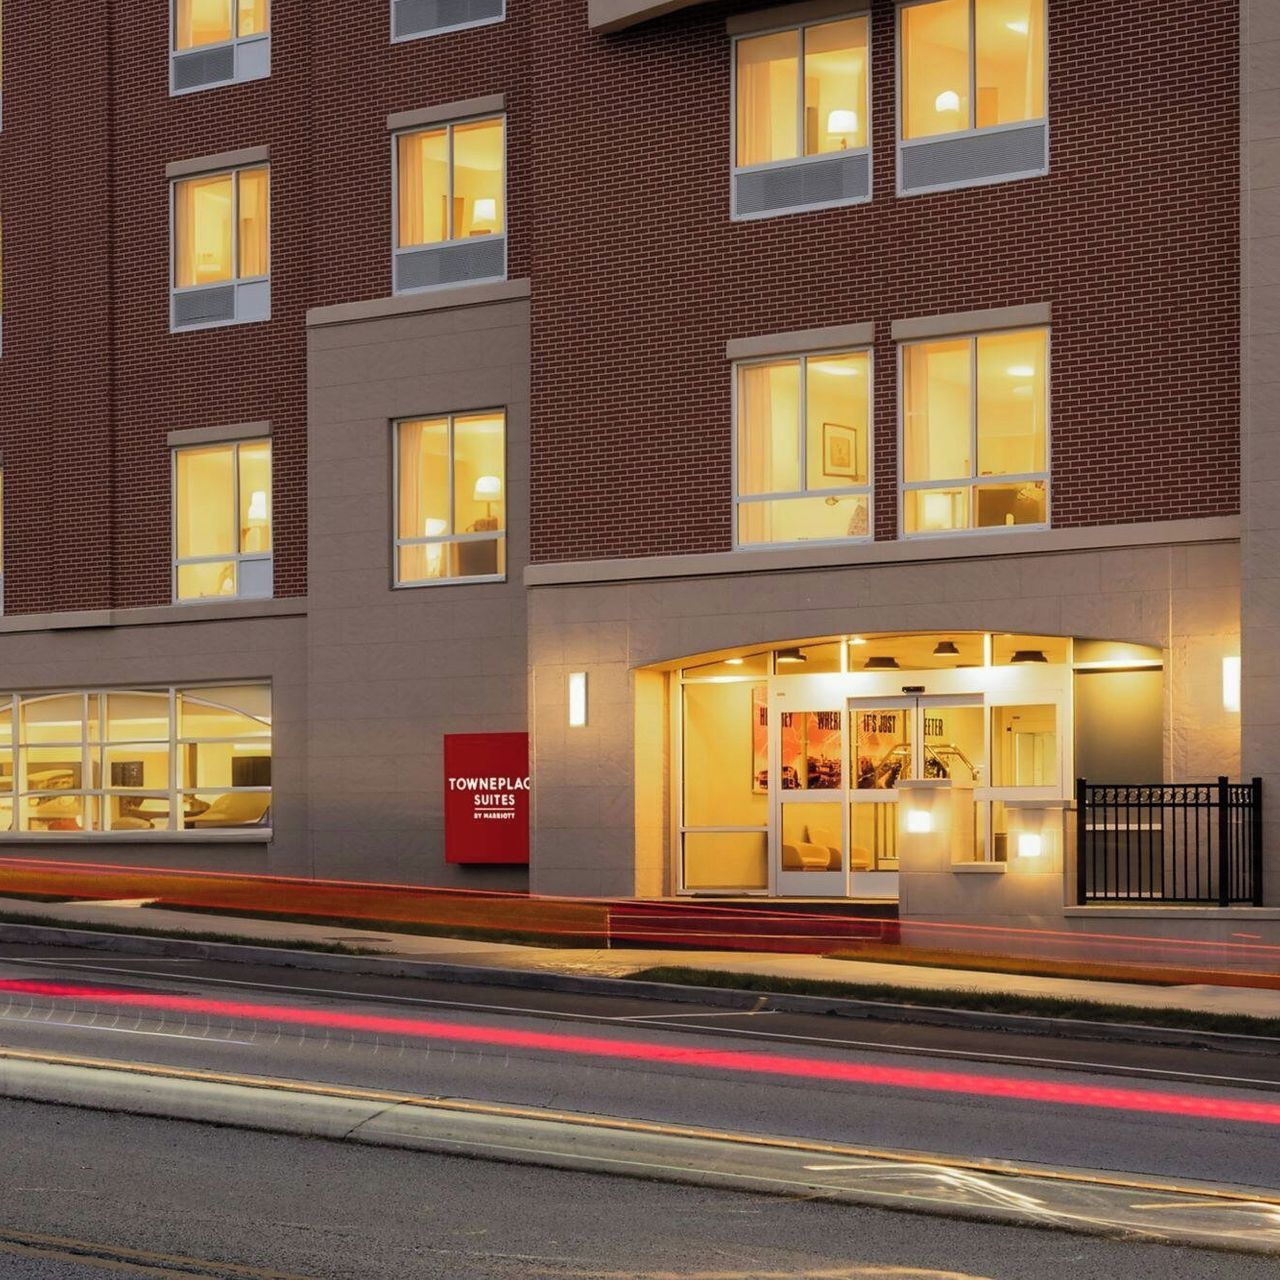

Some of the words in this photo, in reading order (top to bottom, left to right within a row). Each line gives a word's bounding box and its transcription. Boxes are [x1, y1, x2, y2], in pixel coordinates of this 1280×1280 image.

[863, 714, 877, 733] IT'S
[878, 715, 896, 734] JUST
[924, 717, 943, 736] EETER
[448, 777, 530, 791] TOWNEPLAC
[474, 794, 516, 806] SUITES
